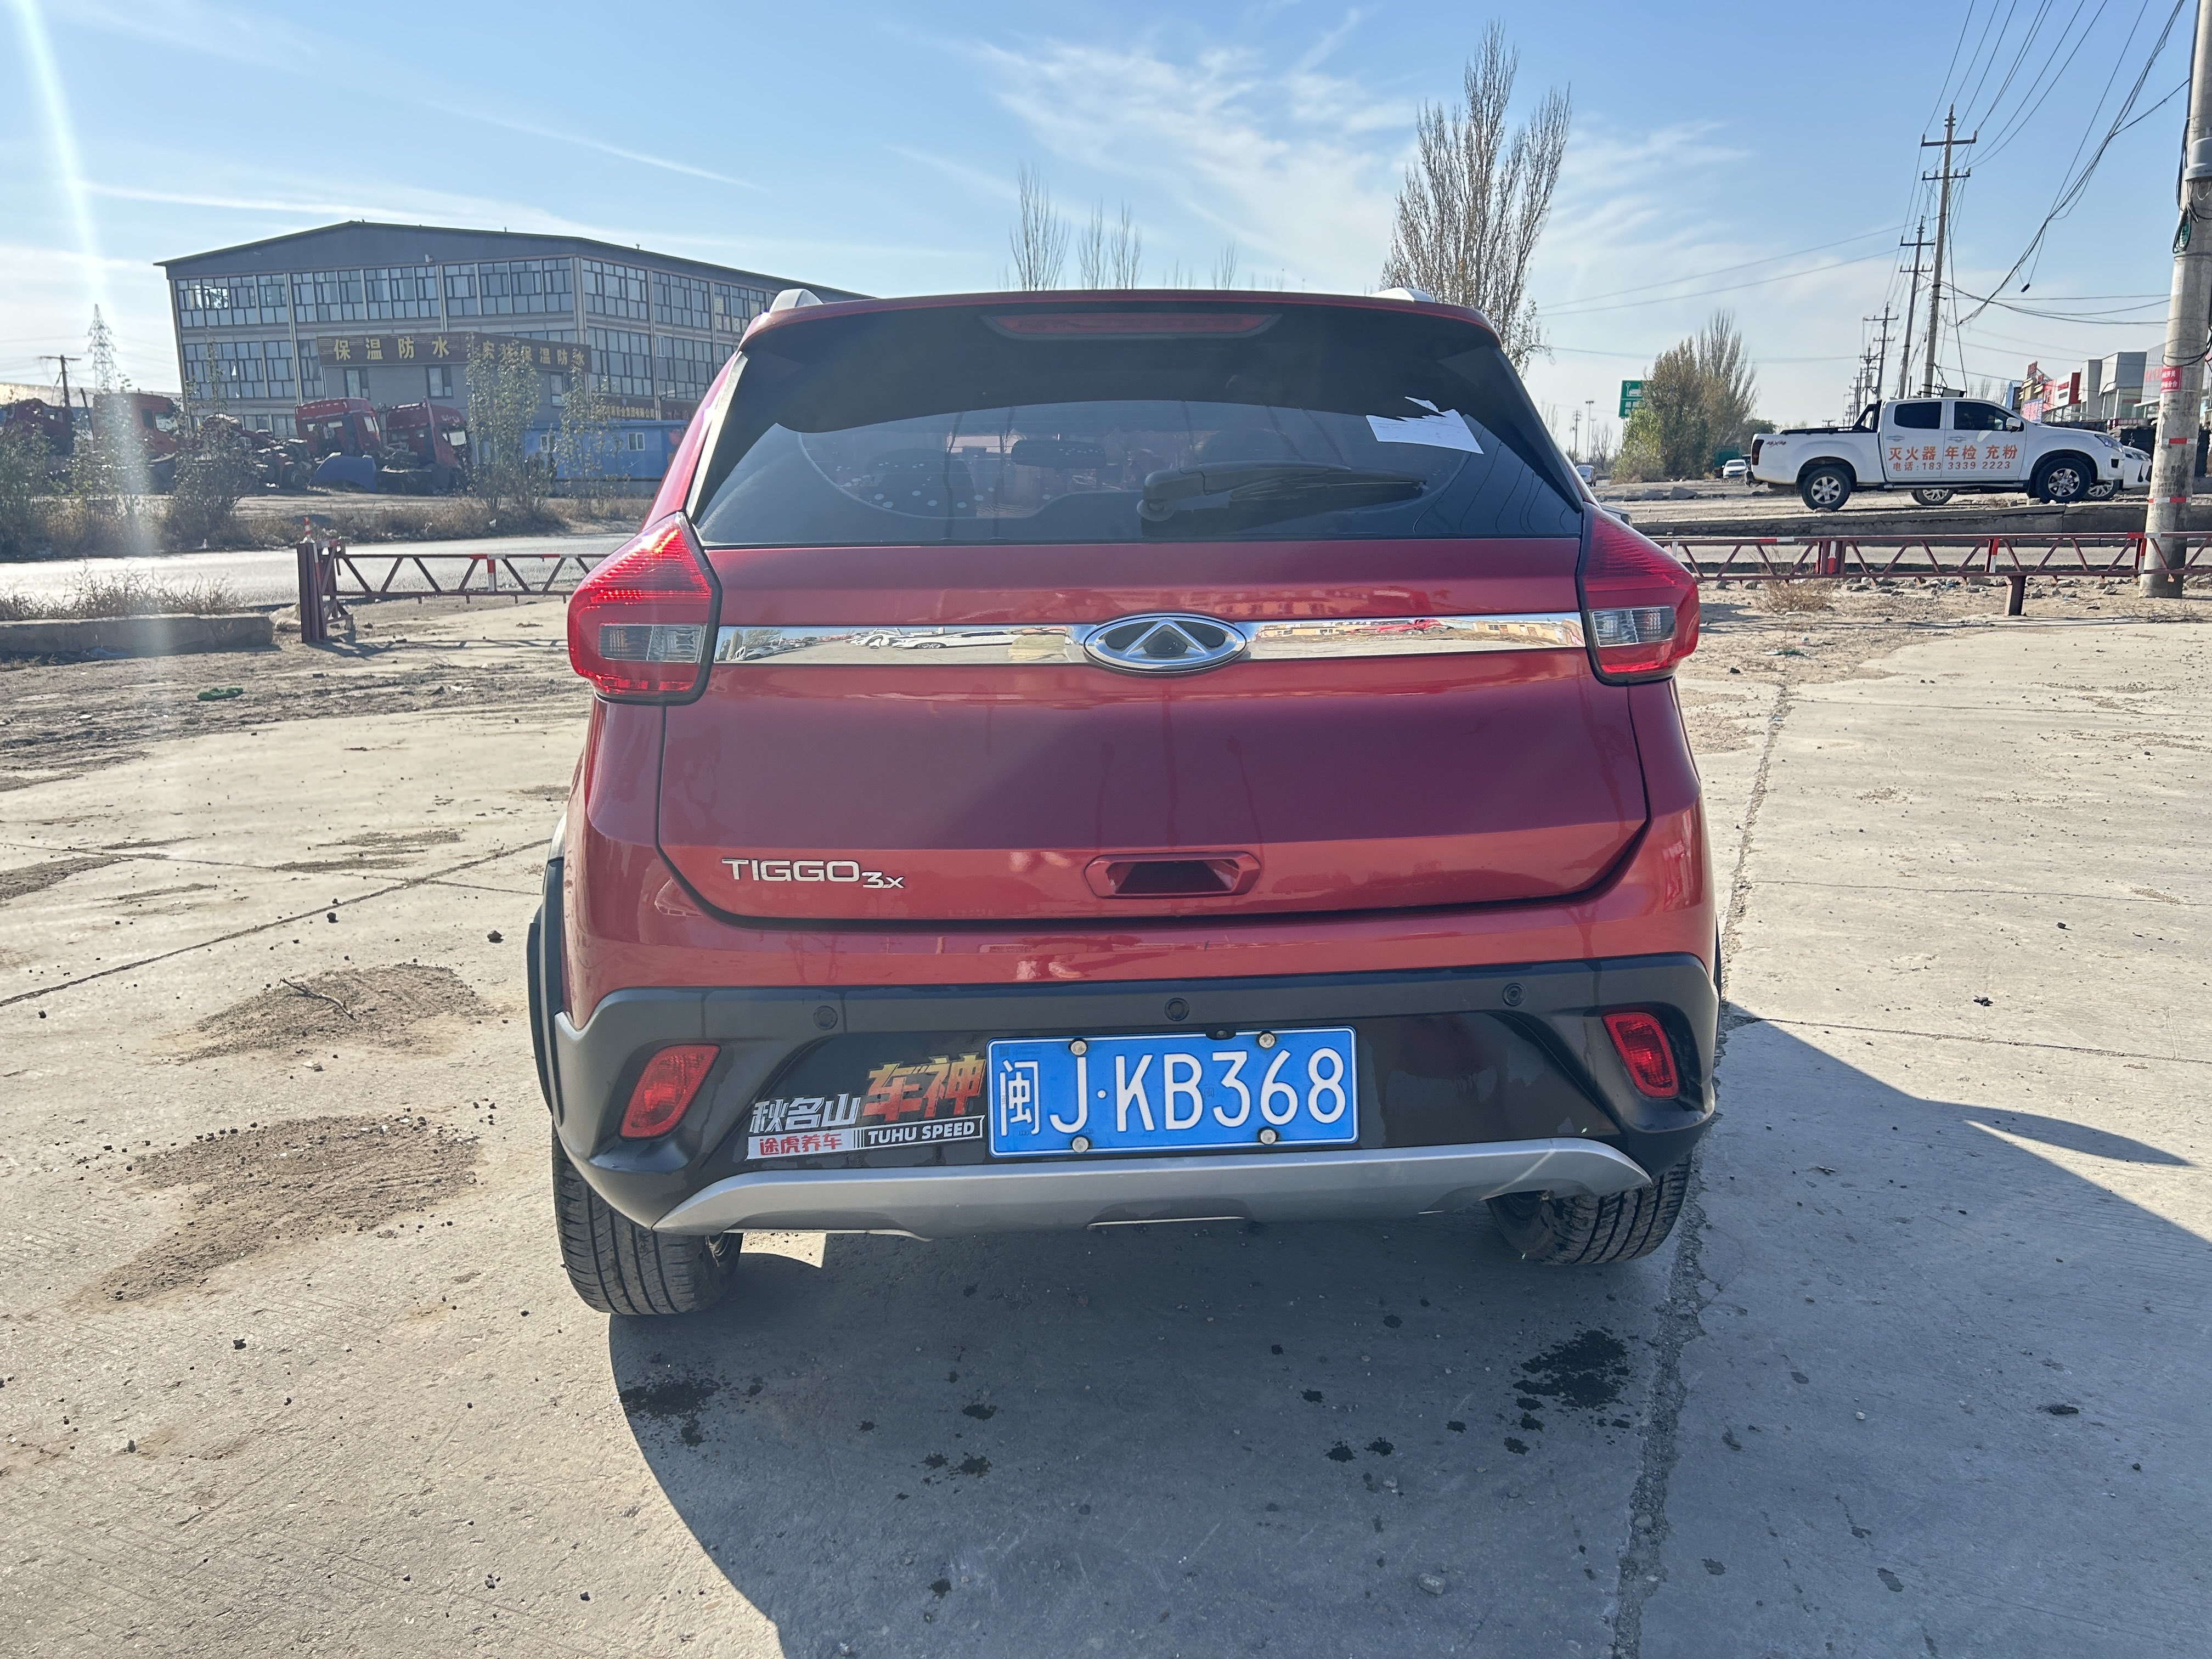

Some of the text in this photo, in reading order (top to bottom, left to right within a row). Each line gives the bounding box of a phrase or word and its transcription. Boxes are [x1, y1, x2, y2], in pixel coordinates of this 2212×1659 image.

[334, 336, 450, 361] 保温防水
[1888, 444, 2018, 461] 灭火器 年检 充粉
[1948, 461, 1976, 470] 3339
[1982, 461, 2011, 470] 2223
[749, 1051, 987, 1133] 秋名山 车神
[759, 1132, 843, 1155] 途虎养车
[868, 1121, 975, 1145] TUHU SPEED
